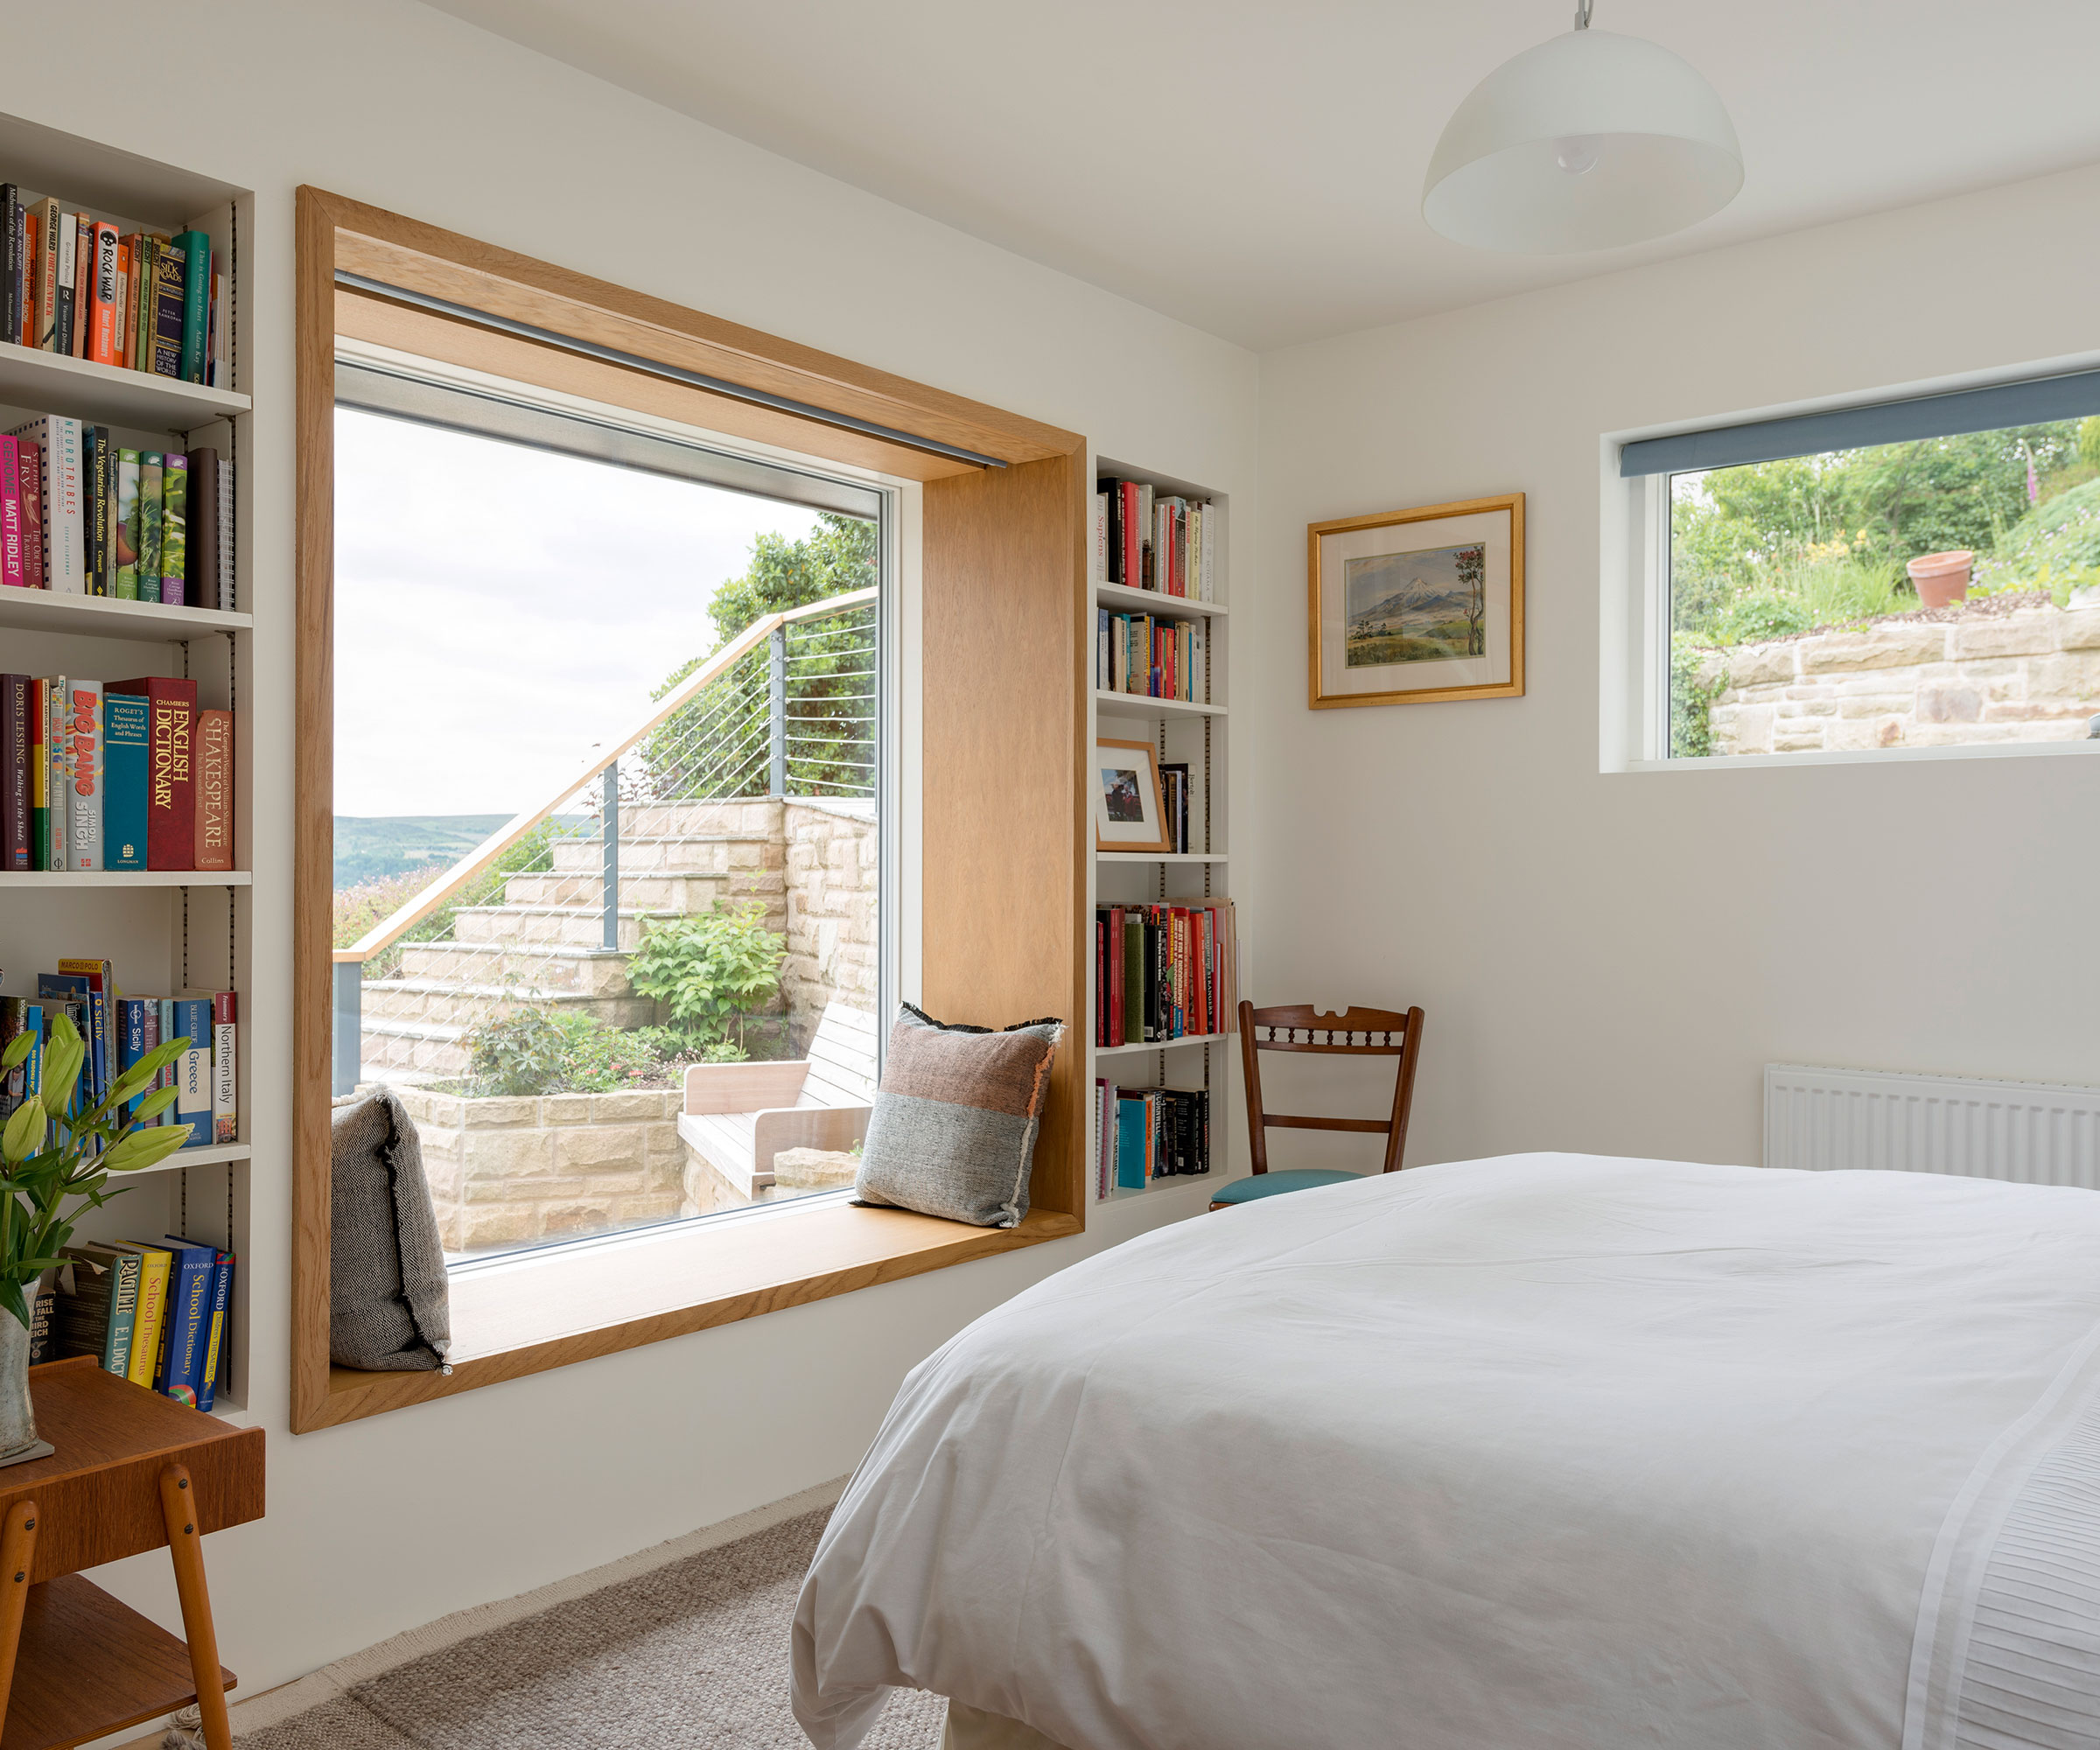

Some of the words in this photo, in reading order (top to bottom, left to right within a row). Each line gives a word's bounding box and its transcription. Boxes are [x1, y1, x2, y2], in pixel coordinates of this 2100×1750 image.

[49, 205, 58, 229] GEORGE
[102, 248, 113, 276] ROCK
[158, 270, 182, 283] ROADS
[161, 262, 178, 275] SILK
[46, 273, 54, 317] GRUNWICK
[102, 276, 112, 300] WAR
[102, 309, 110, 326] Robert
[158, 312, 182, 322] RANKOPAN
[156, 366, 176, 375] WORLD
[157, 354, 177, 363] HISTORY
[4, 441, 15, 494] GENOME
[19, 455, 32, 488] FRY
[65, 420, 75, 514] NEUROTRIBES
[95, 455, 105, 497] Vegetarian
[5, 499, 17, 531] MATT
[96, 499, 105, 542] Revolution
[7, 534, 19, 577] RIDLEY
[16, 683, 24, 717] DORIS
[74, 690, 97, 734] BIG
[16, 721, 24, 764] LESSING
[111, 722, 129, 731] English
[156, 709, 172, 809] DICTIONARY
[173, 710, 189, 782] ENGLISH
[74, 735, 95, 796] BANG
[15, 769, 24, 796] Walking
[205, 718, 221, 848] SHAKESPEARE
[75, 802, 88, 850] SINGH
[84, 962, 99, 971] POLO
[66, 1004, 80, 1022] Time
[130, 1028, 141, 1052] Sicily
[220, 1026, 232, 1076] Northern
[189, 1051, 200, 1094] Greece
[220, 1080, 233, 1103] Italy
[36, 1298, 53, 1308] RISE
[116, 1259, 139, 1315] RAGTIME
[144, 1278, 161, 1323] School
[189, 1275, 205, 1320] School
[37, 1306, 54, 1315] FALL
[31, 1328, 48, 1338] EICH
[114, 1338, 128, 1347] L.
[115, 1326, 130, 1337] E.
[139, 1325, 153, 1376] Thesaurus
[182, 1322, 197, 1376] Dictionary
[207, 1340, 218, 1380] THESAURUS
